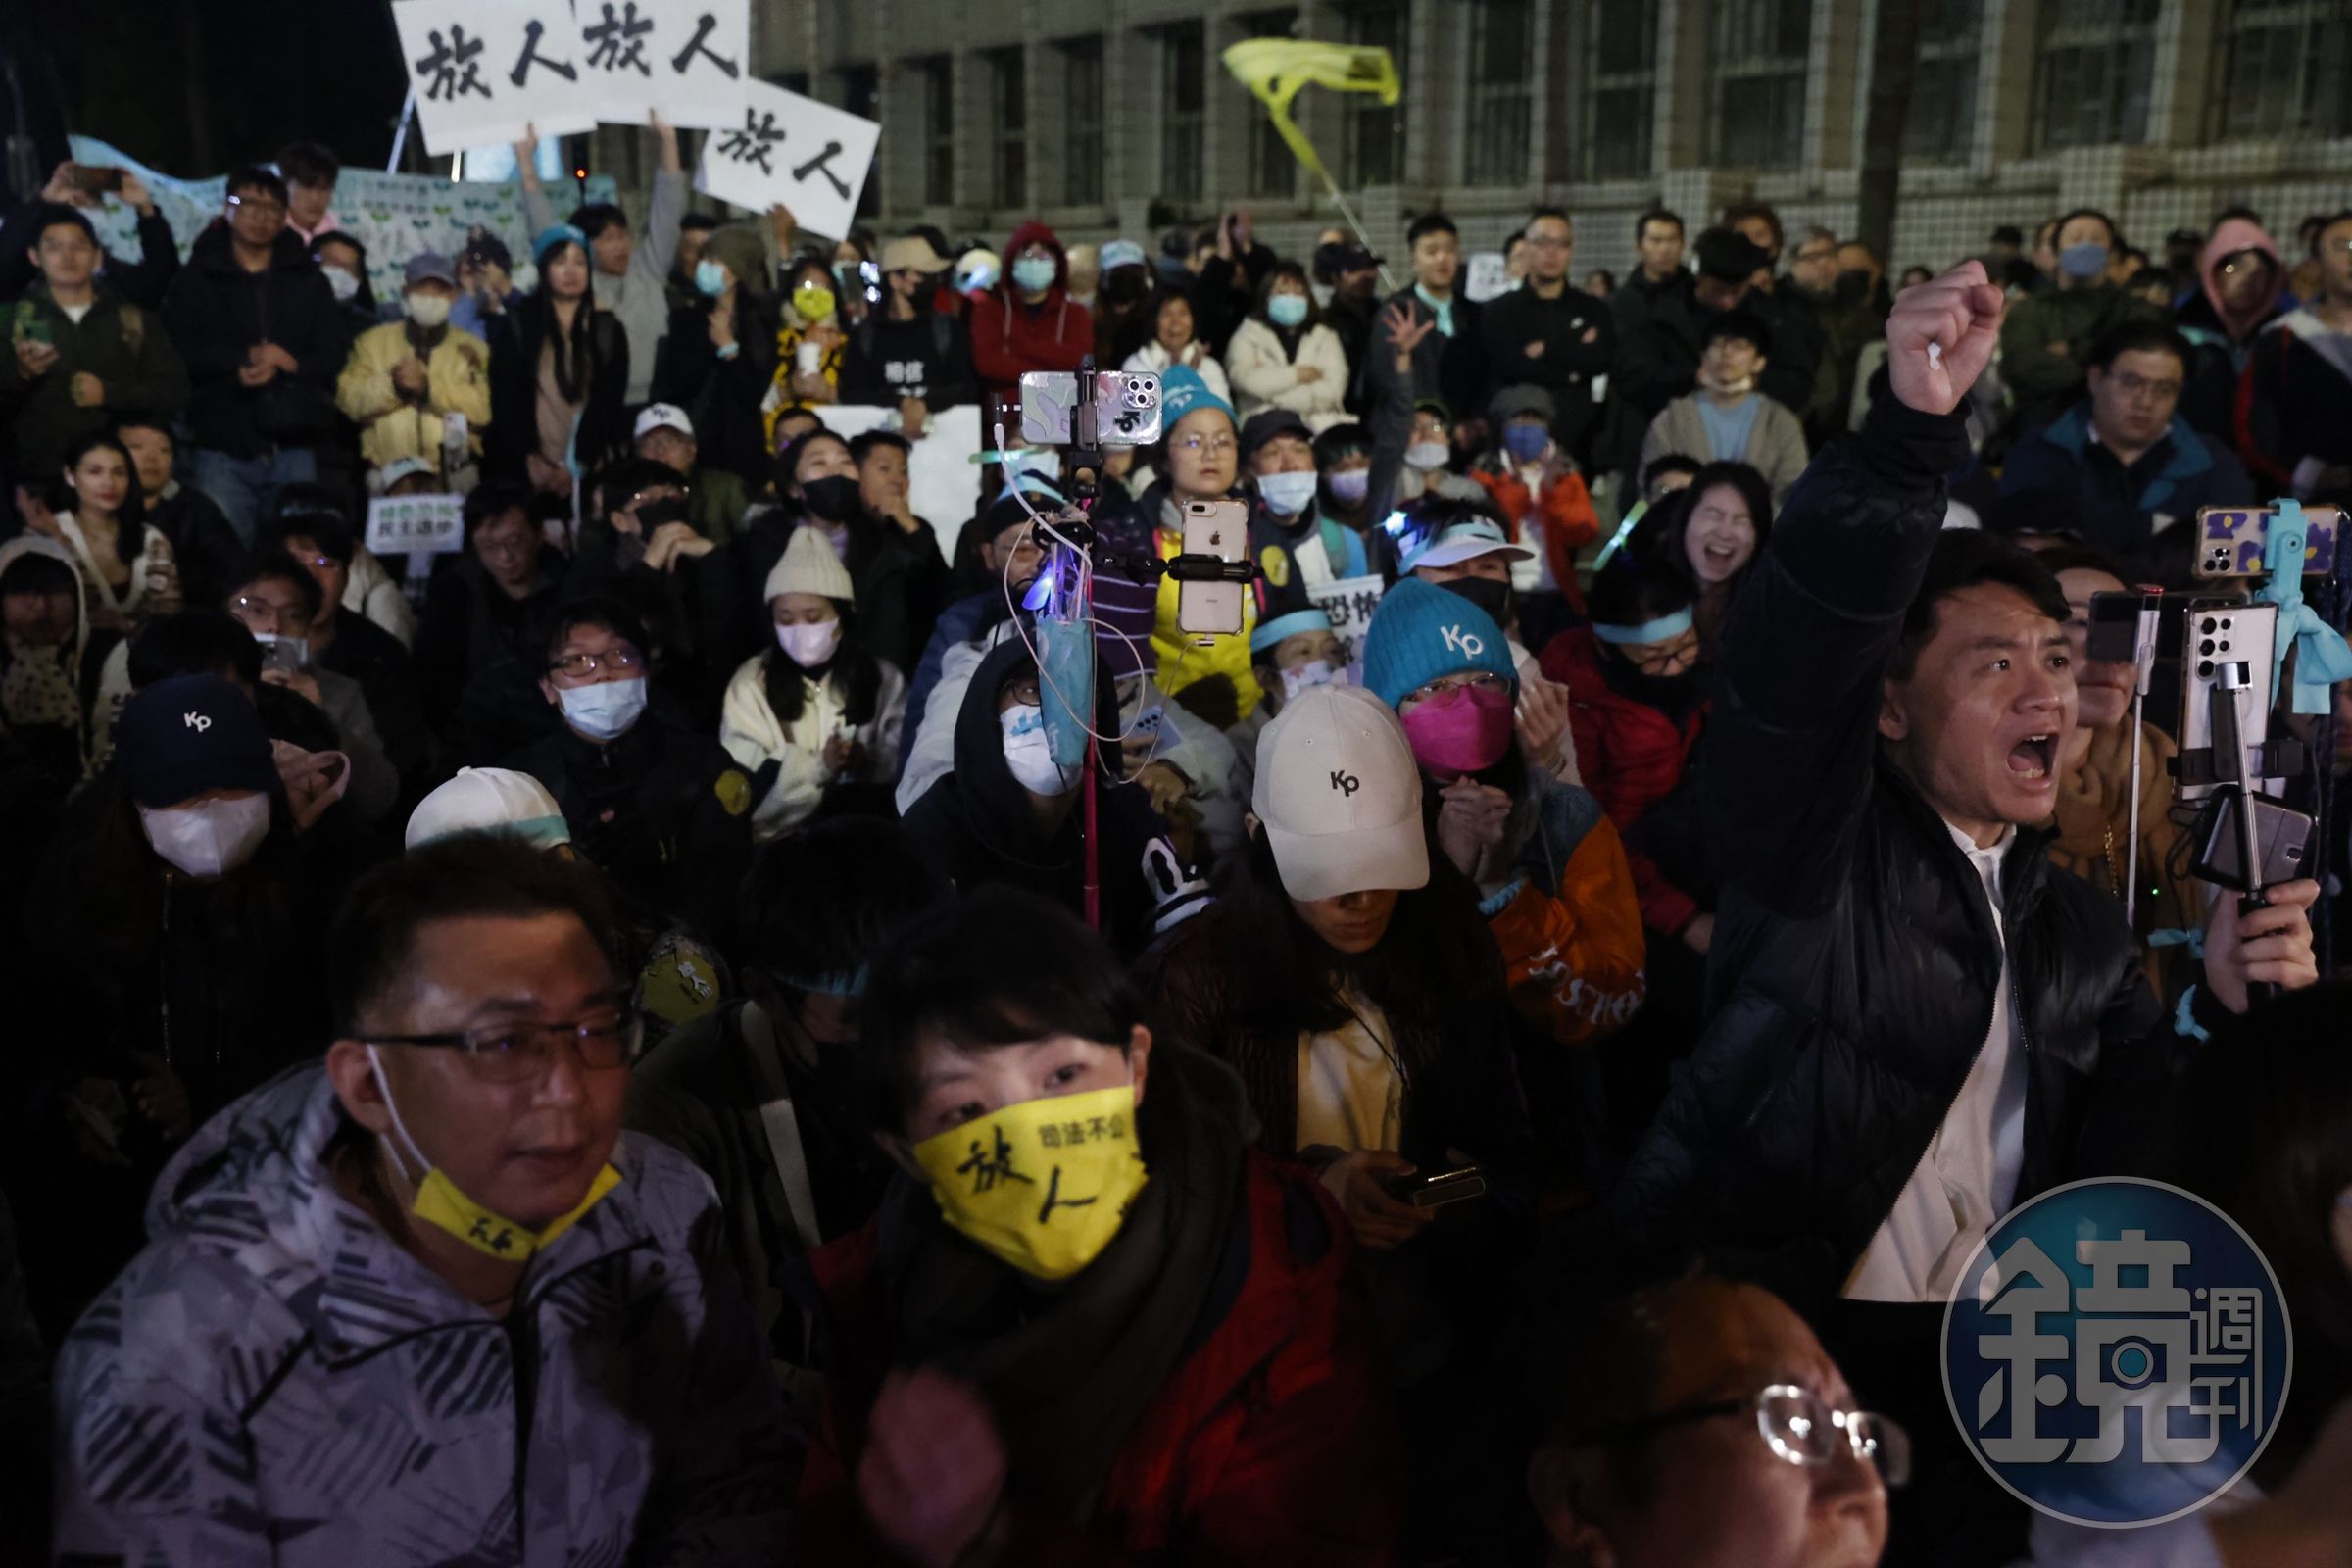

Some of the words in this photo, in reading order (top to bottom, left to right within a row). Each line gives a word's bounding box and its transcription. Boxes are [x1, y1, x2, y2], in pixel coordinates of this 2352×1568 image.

[416, 19, 578, 101] 放人
[583, 1, 738, 79] 放人
[717, 107, 851, 201] 放人
[957, 1124, 1099, 1224] 放人
